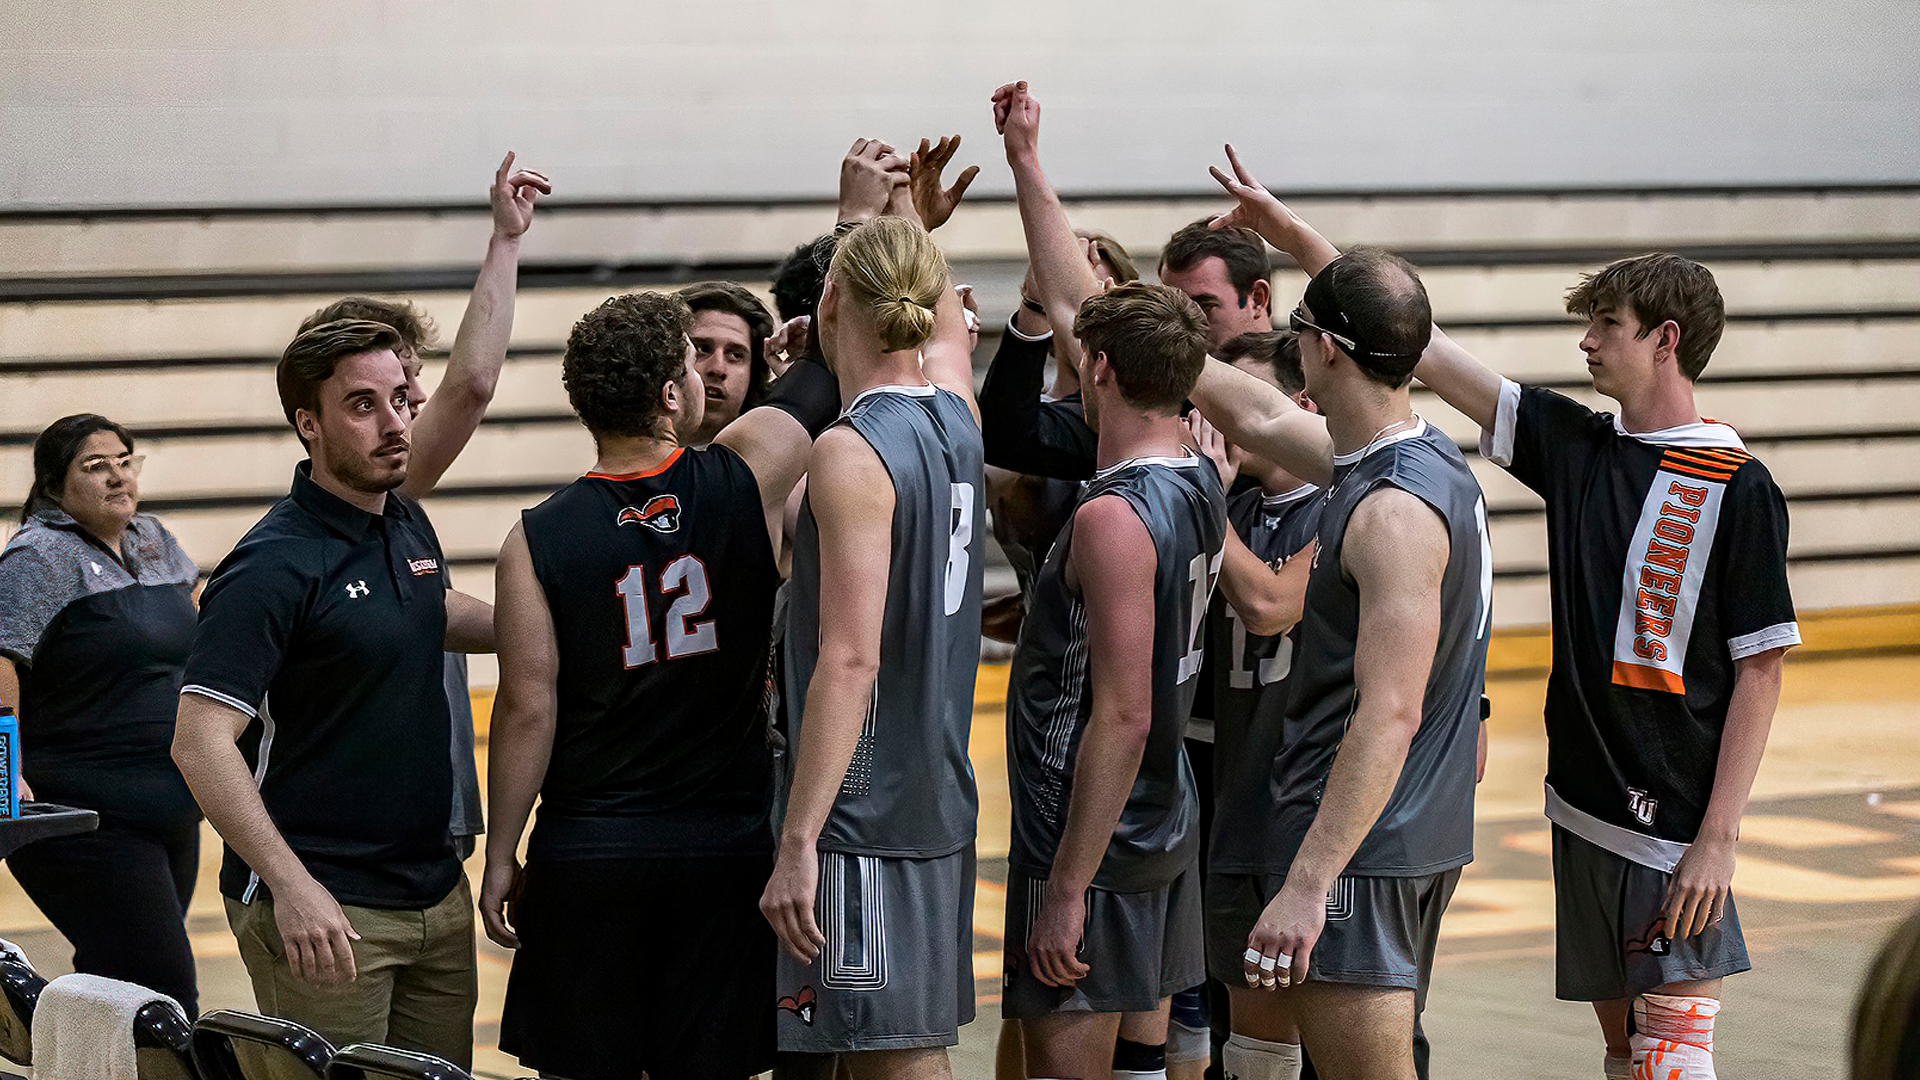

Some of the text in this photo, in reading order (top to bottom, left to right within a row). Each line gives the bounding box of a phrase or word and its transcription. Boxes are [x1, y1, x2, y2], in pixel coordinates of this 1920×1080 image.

[615, 553, 719, 670] 12
[1632, 480, 1709, 662] PIONEERS
[1626, 786, 1658, 827] TU
